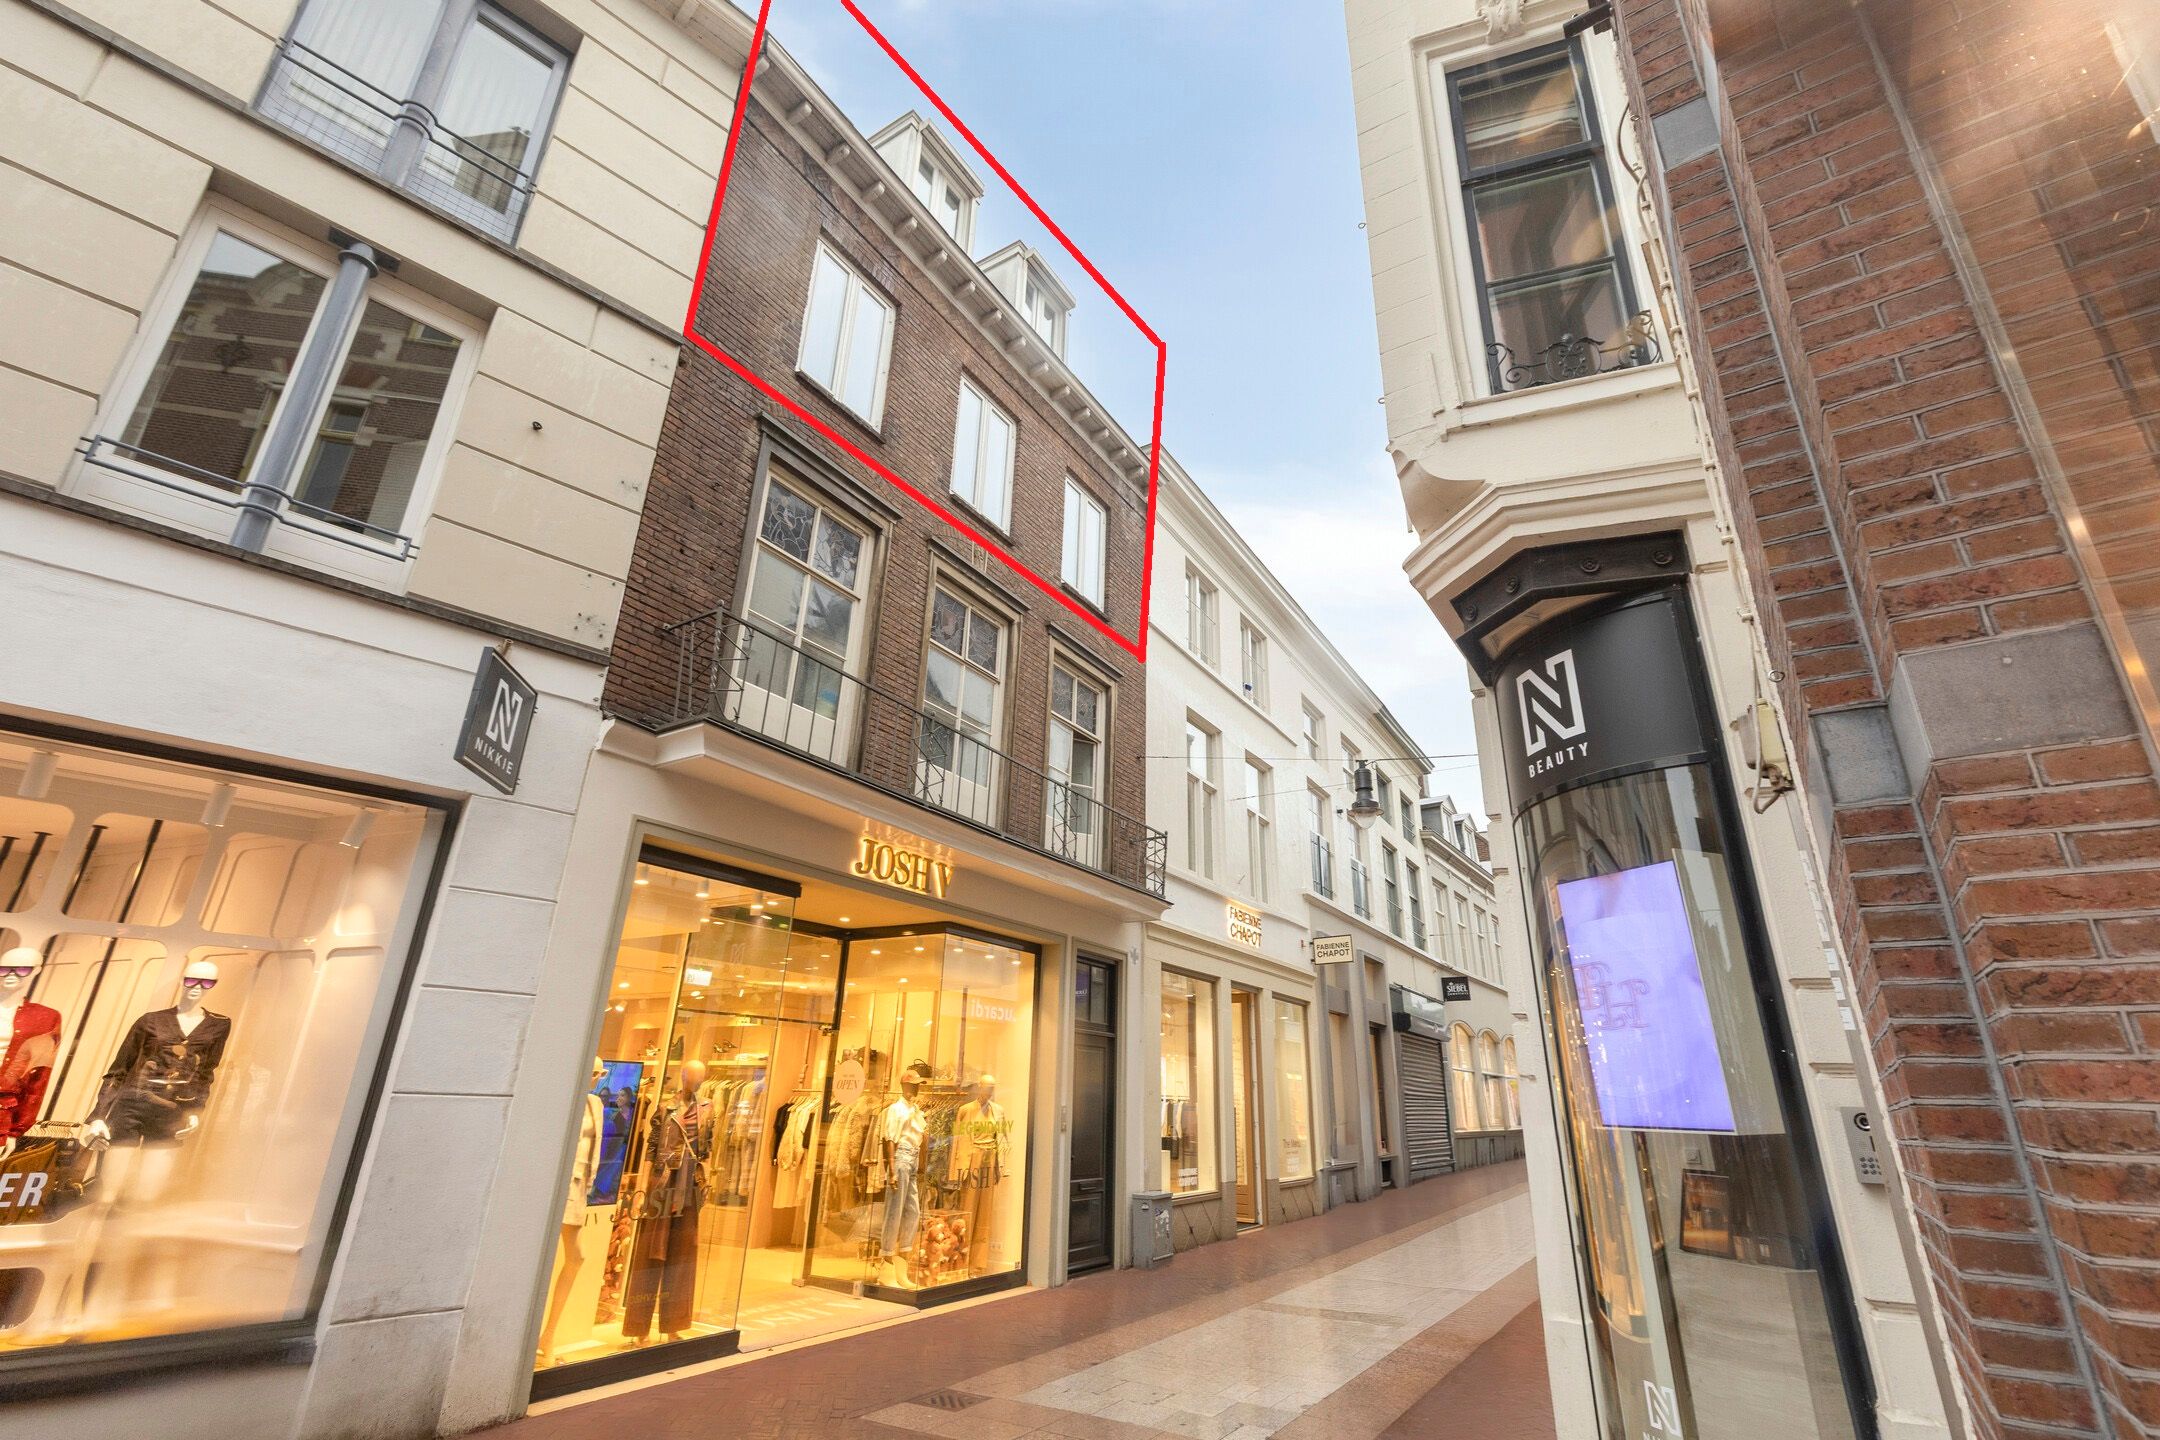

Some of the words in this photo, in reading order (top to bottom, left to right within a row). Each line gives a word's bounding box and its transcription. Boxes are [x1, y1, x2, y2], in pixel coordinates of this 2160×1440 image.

[1515, 648, 1587, 757] N
[484, 678, 524, 753] N
[474, 736, 514, 775] NIKKIE
[1528, 742, 1588, 778] BEAUTY
[854, 838, 934, 894] JOSH
[935, 861, 954, 898] V
[1229, 906, 1262, 931] FABIENNE
[1230, 923, 1262, 947] CHAPOT
[1316, 942, 1350, 950] FABIENNE
[1317, 949, 1350, 958] CHAPOT
[836, 1079, 859, 1090] OPEN
[952, 1120, 1015, 1136] LEGENDARY
[957, 1167, 991, 1190] JOSH
[610, 1187, 687, 1223] JOSH
